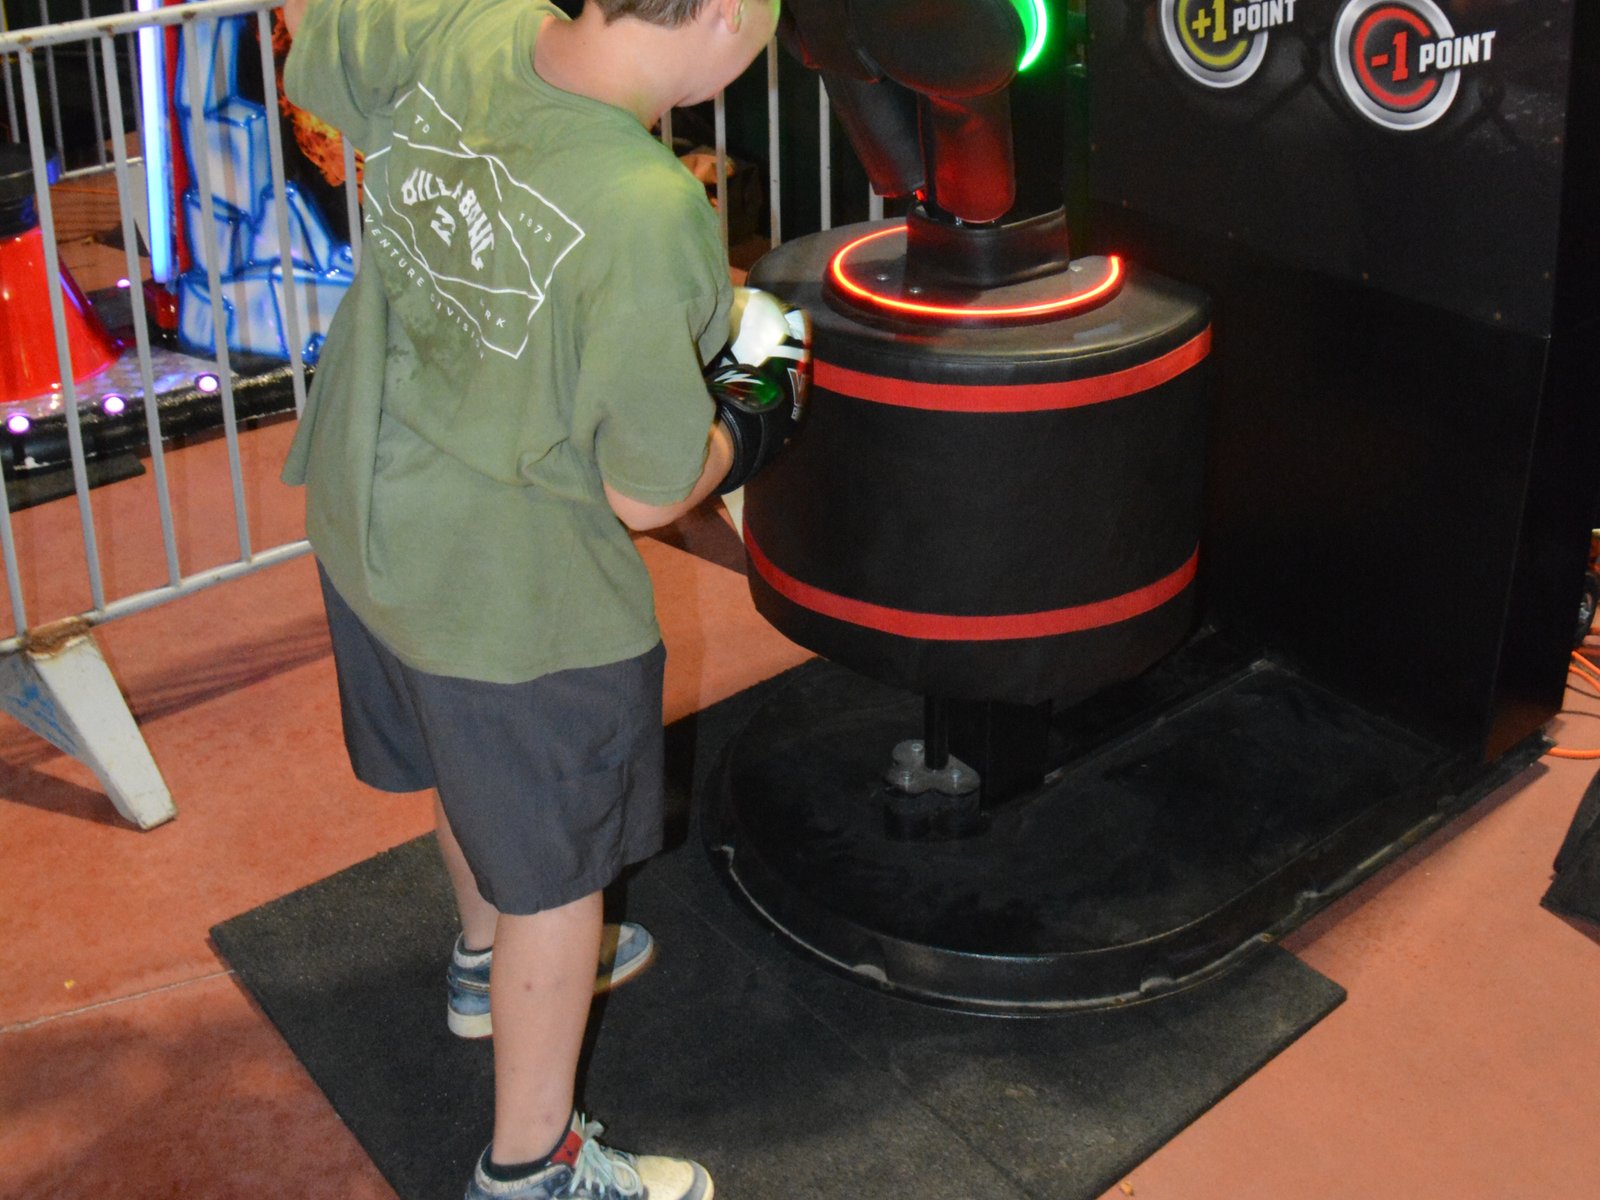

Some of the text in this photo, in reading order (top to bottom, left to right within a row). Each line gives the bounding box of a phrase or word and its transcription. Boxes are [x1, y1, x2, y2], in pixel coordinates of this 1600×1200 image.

[1370, 30, 1497, 82] -1 POINT
[364, 214, 425, 287] VENTURE
[519, 212, 552, 243] 1973
